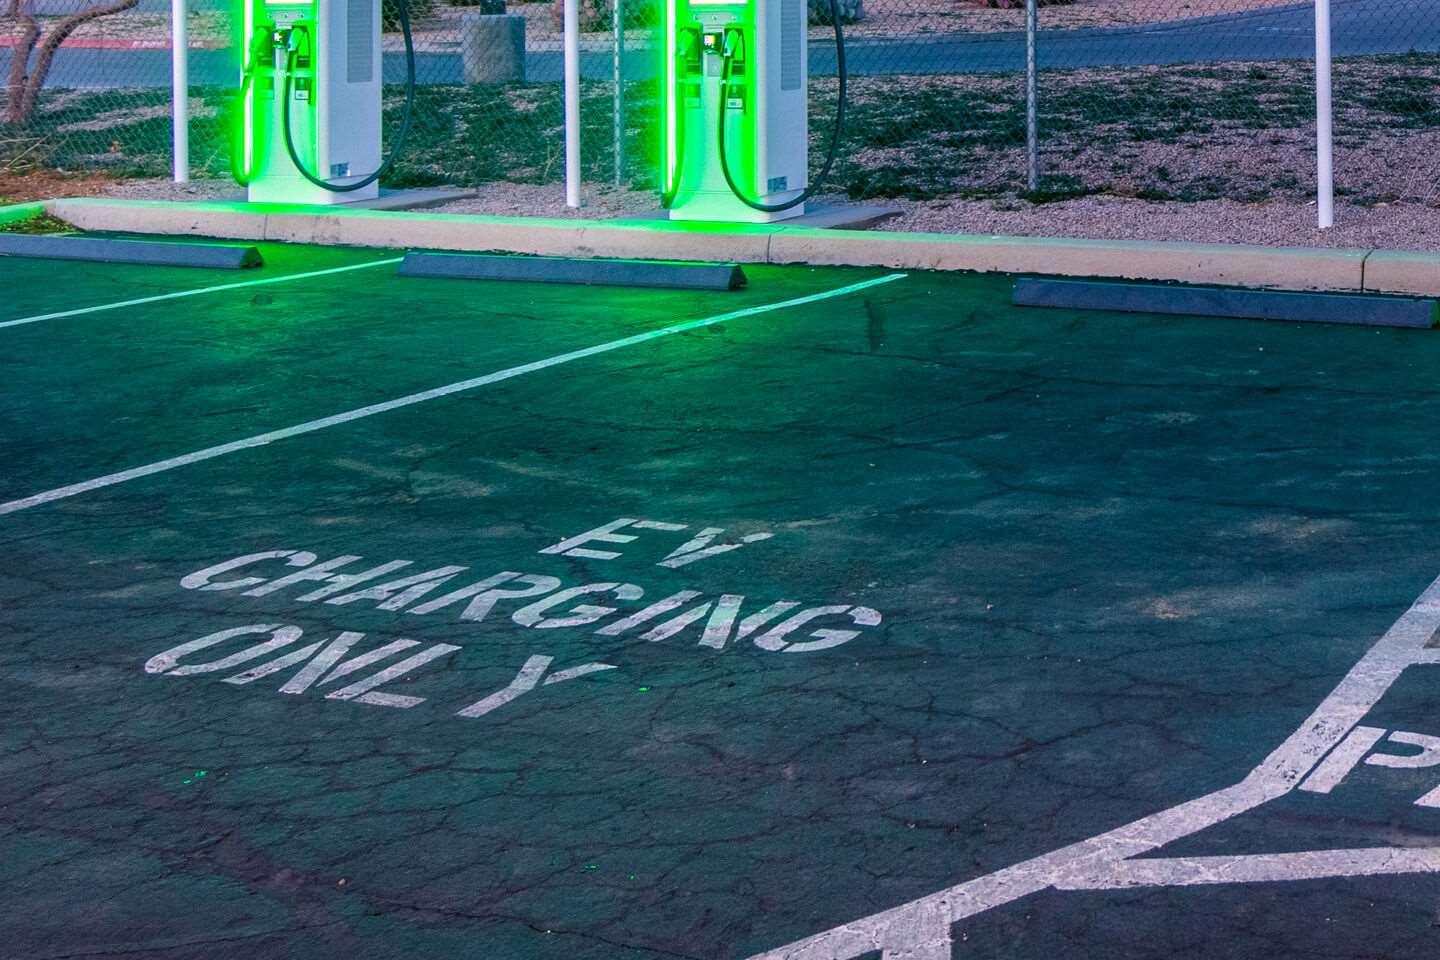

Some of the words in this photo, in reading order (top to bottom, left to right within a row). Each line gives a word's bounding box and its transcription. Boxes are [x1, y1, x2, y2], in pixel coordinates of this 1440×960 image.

[539, 518, 773, 569] EV
[180, 550, 882, 653] CHARGING
[144, 623, 618, 718] ONLY
